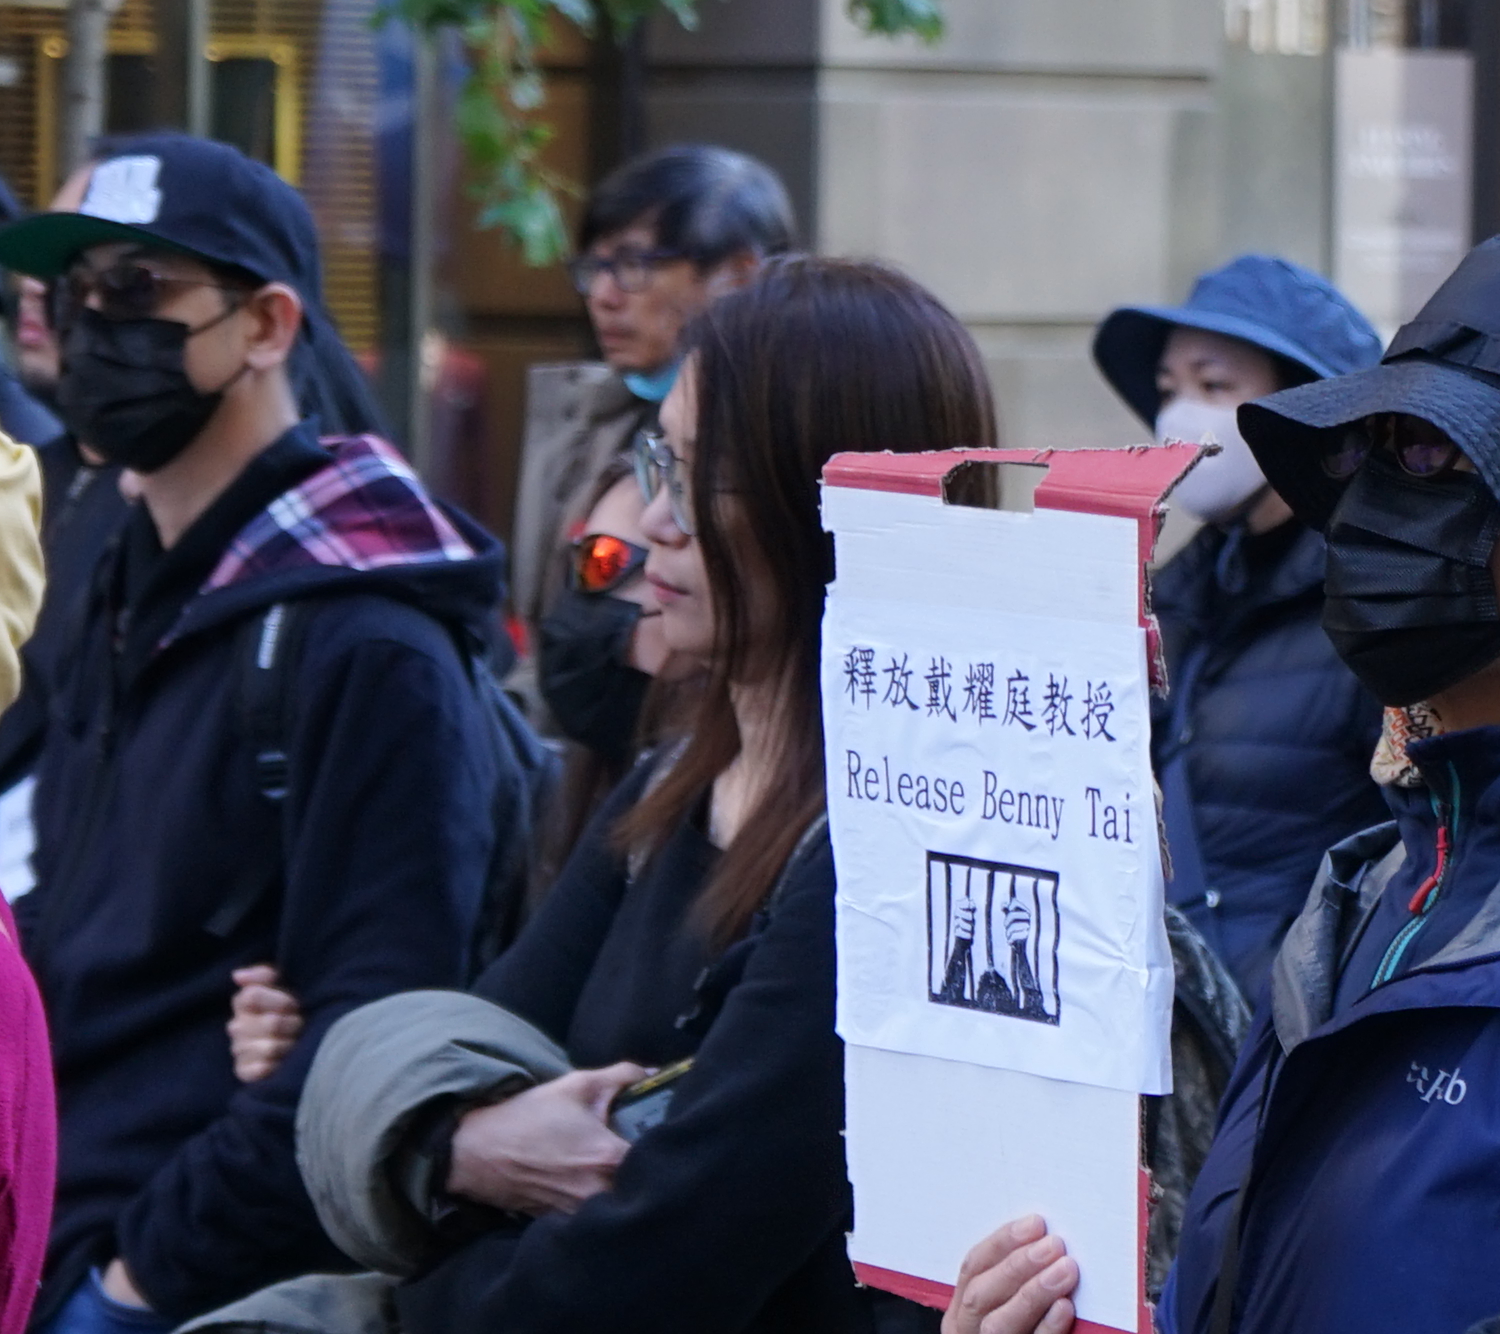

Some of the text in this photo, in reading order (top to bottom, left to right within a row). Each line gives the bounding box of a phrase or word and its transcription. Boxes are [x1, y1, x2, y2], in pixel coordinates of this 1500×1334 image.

[843, 646, 1117, 743] 釋放戴耀庭教授
[846, 750, 1134, 844] Release Benny Tai
